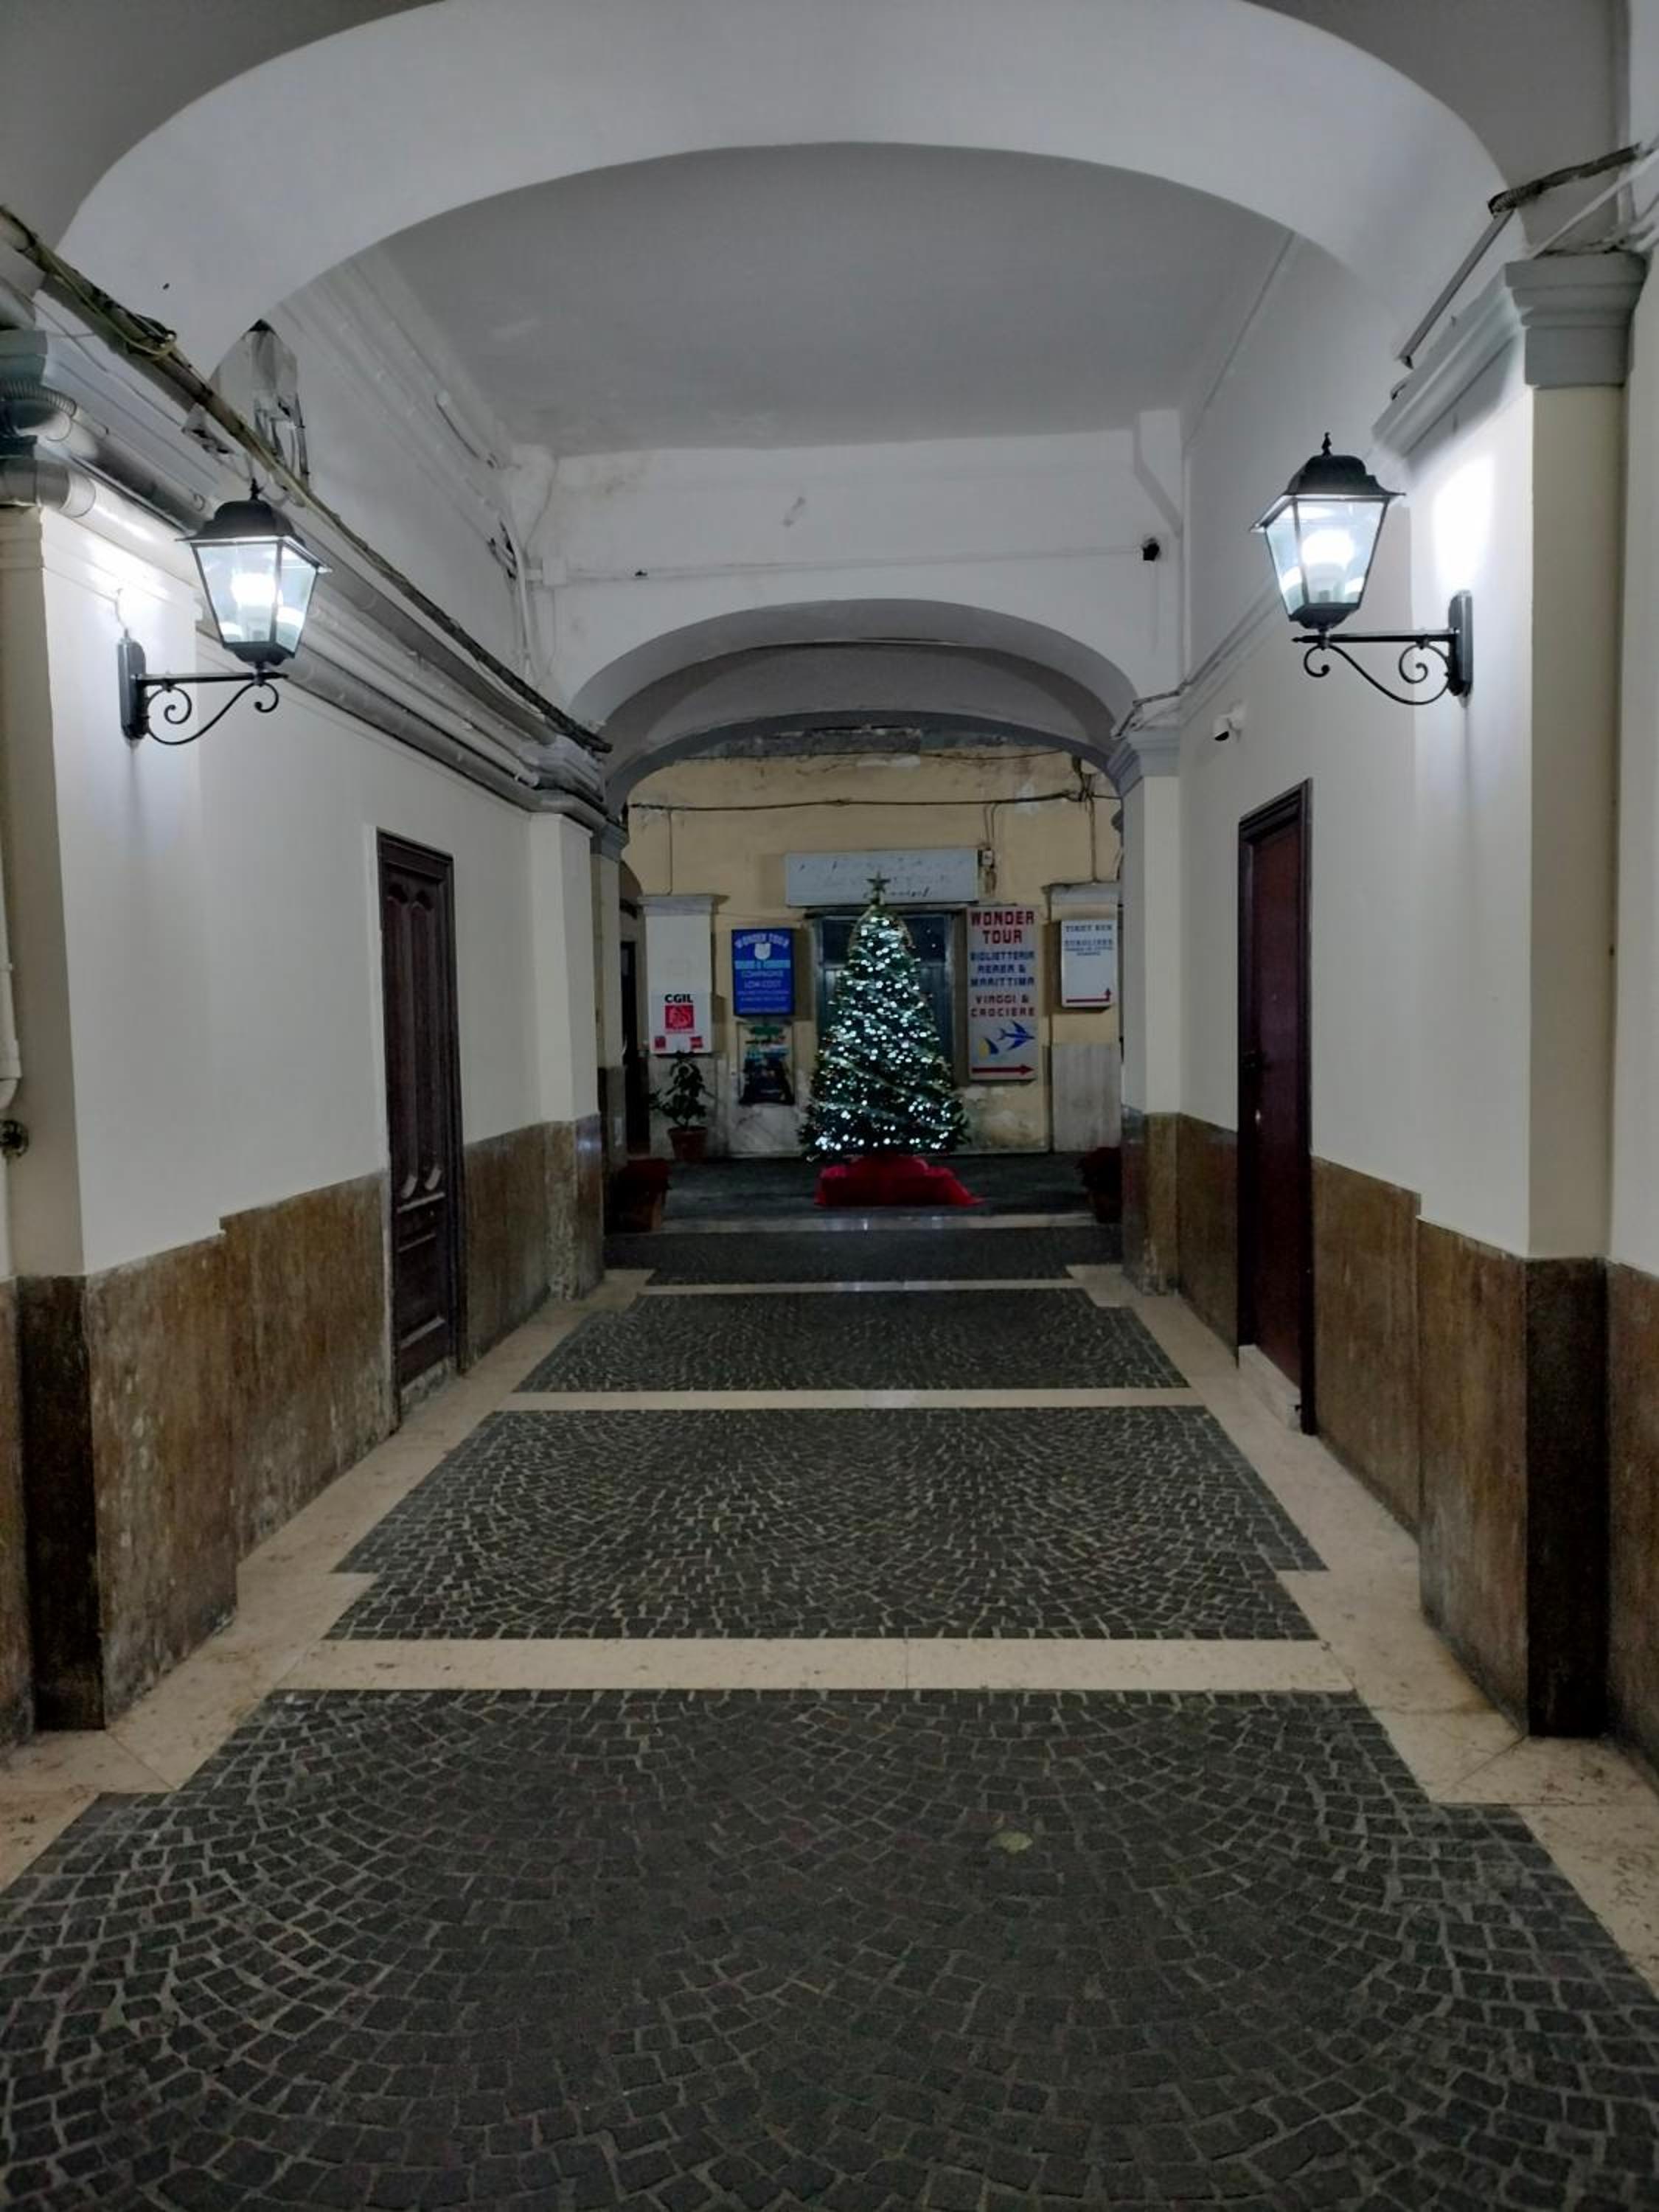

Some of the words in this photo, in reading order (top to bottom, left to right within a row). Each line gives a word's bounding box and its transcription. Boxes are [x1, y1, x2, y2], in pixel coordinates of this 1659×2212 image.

[970, 911, 1034, 925] WONDER
[982, 930, 1022, 944] TOUR
[978, 964, 1015, 973] AEREA
[1019, 964, 1026, 973] &
[970, 977, 1034, 987] MARITTIMA
[664, 993, 693, 1003] CGIL
[975, 995, 1016, 1004] VIAGGI
[1021, 995, 1029, 1004] &
[970, 1007, 1034, 1017] CROCIERE
